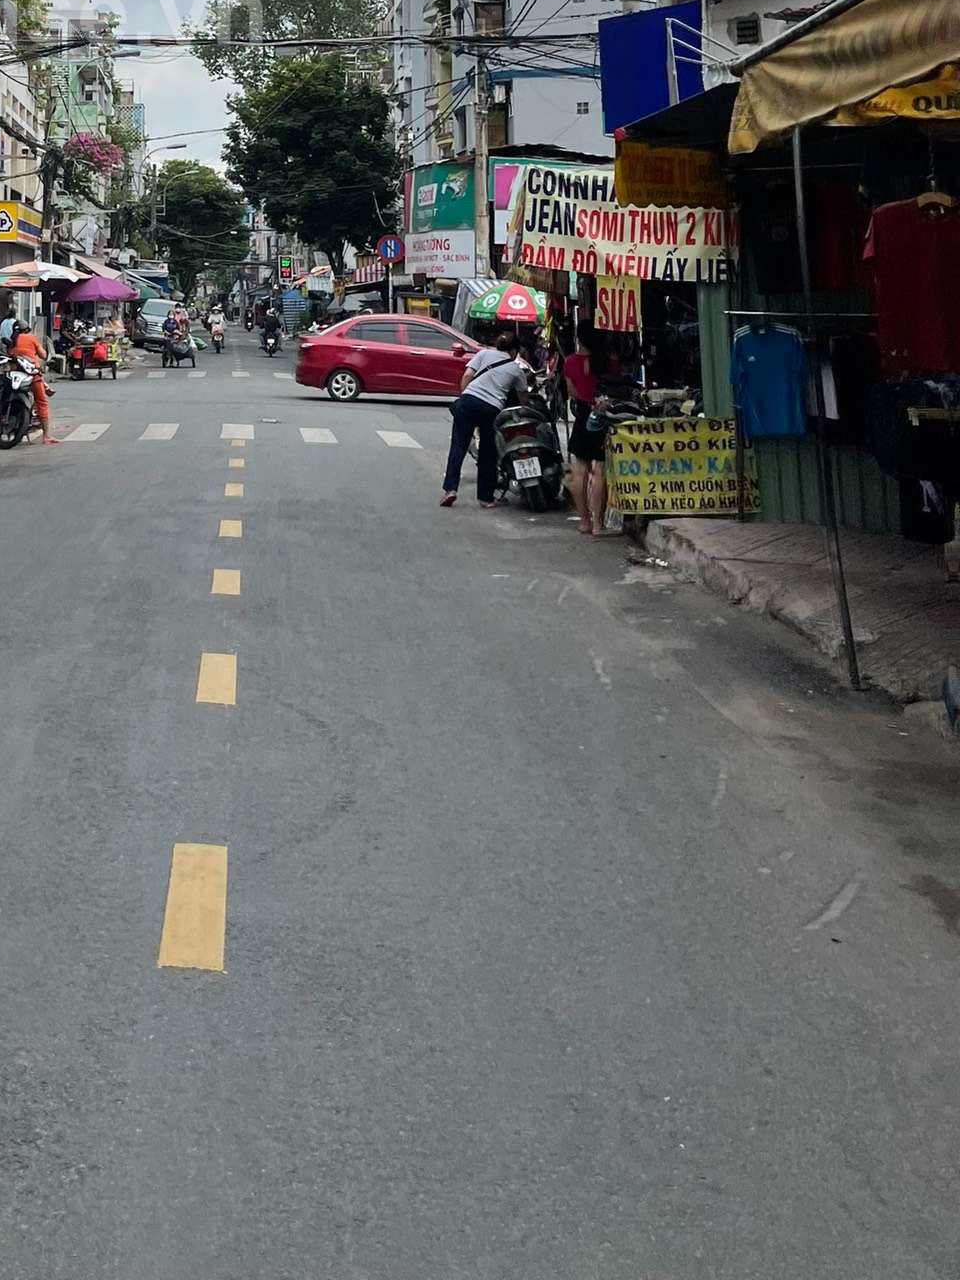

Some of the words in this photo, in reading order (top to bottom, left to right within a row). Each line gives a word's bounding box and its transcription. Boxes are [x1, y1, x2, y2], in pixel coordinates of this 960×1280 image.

[525, 197, 578, 237] JEAN
[628, 209, 678, 246] THUN
[685, 210, 697, 246] 2
[648, 481, 657, 494] 2
[660, 480, 685, 493] KIM
